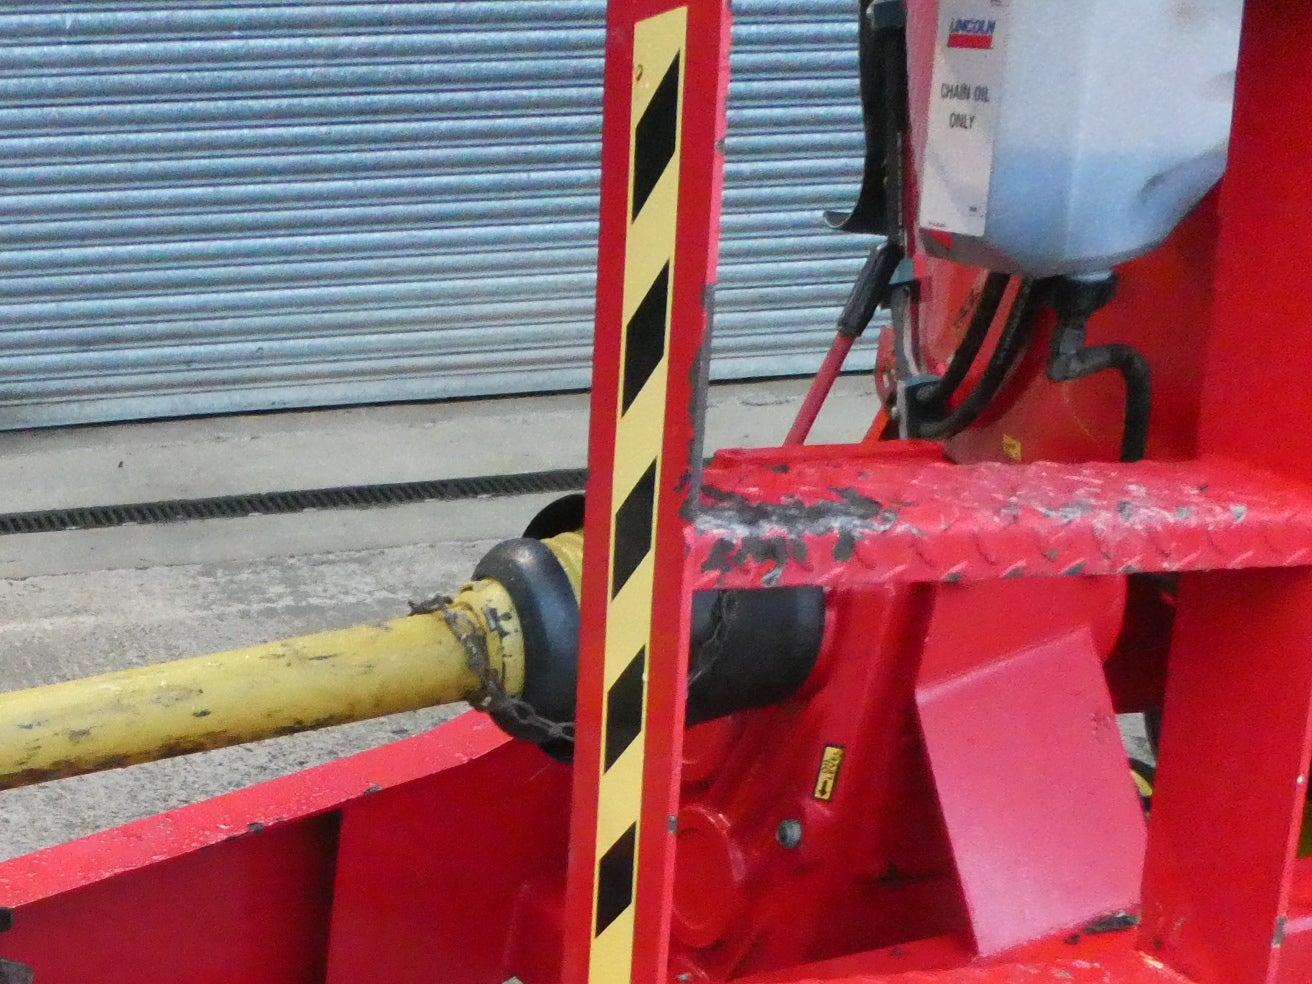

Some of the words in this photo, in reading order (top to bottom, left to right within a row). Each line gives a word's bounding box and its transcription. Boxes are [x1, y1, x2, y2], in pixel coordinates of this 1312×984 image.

[949, 17, 996, 34] LINCOLN
[941, 83, 971, 101] CHAIN
[974, 86, 990, 103] OIL
[949, 112, 975, 129] ONLY
